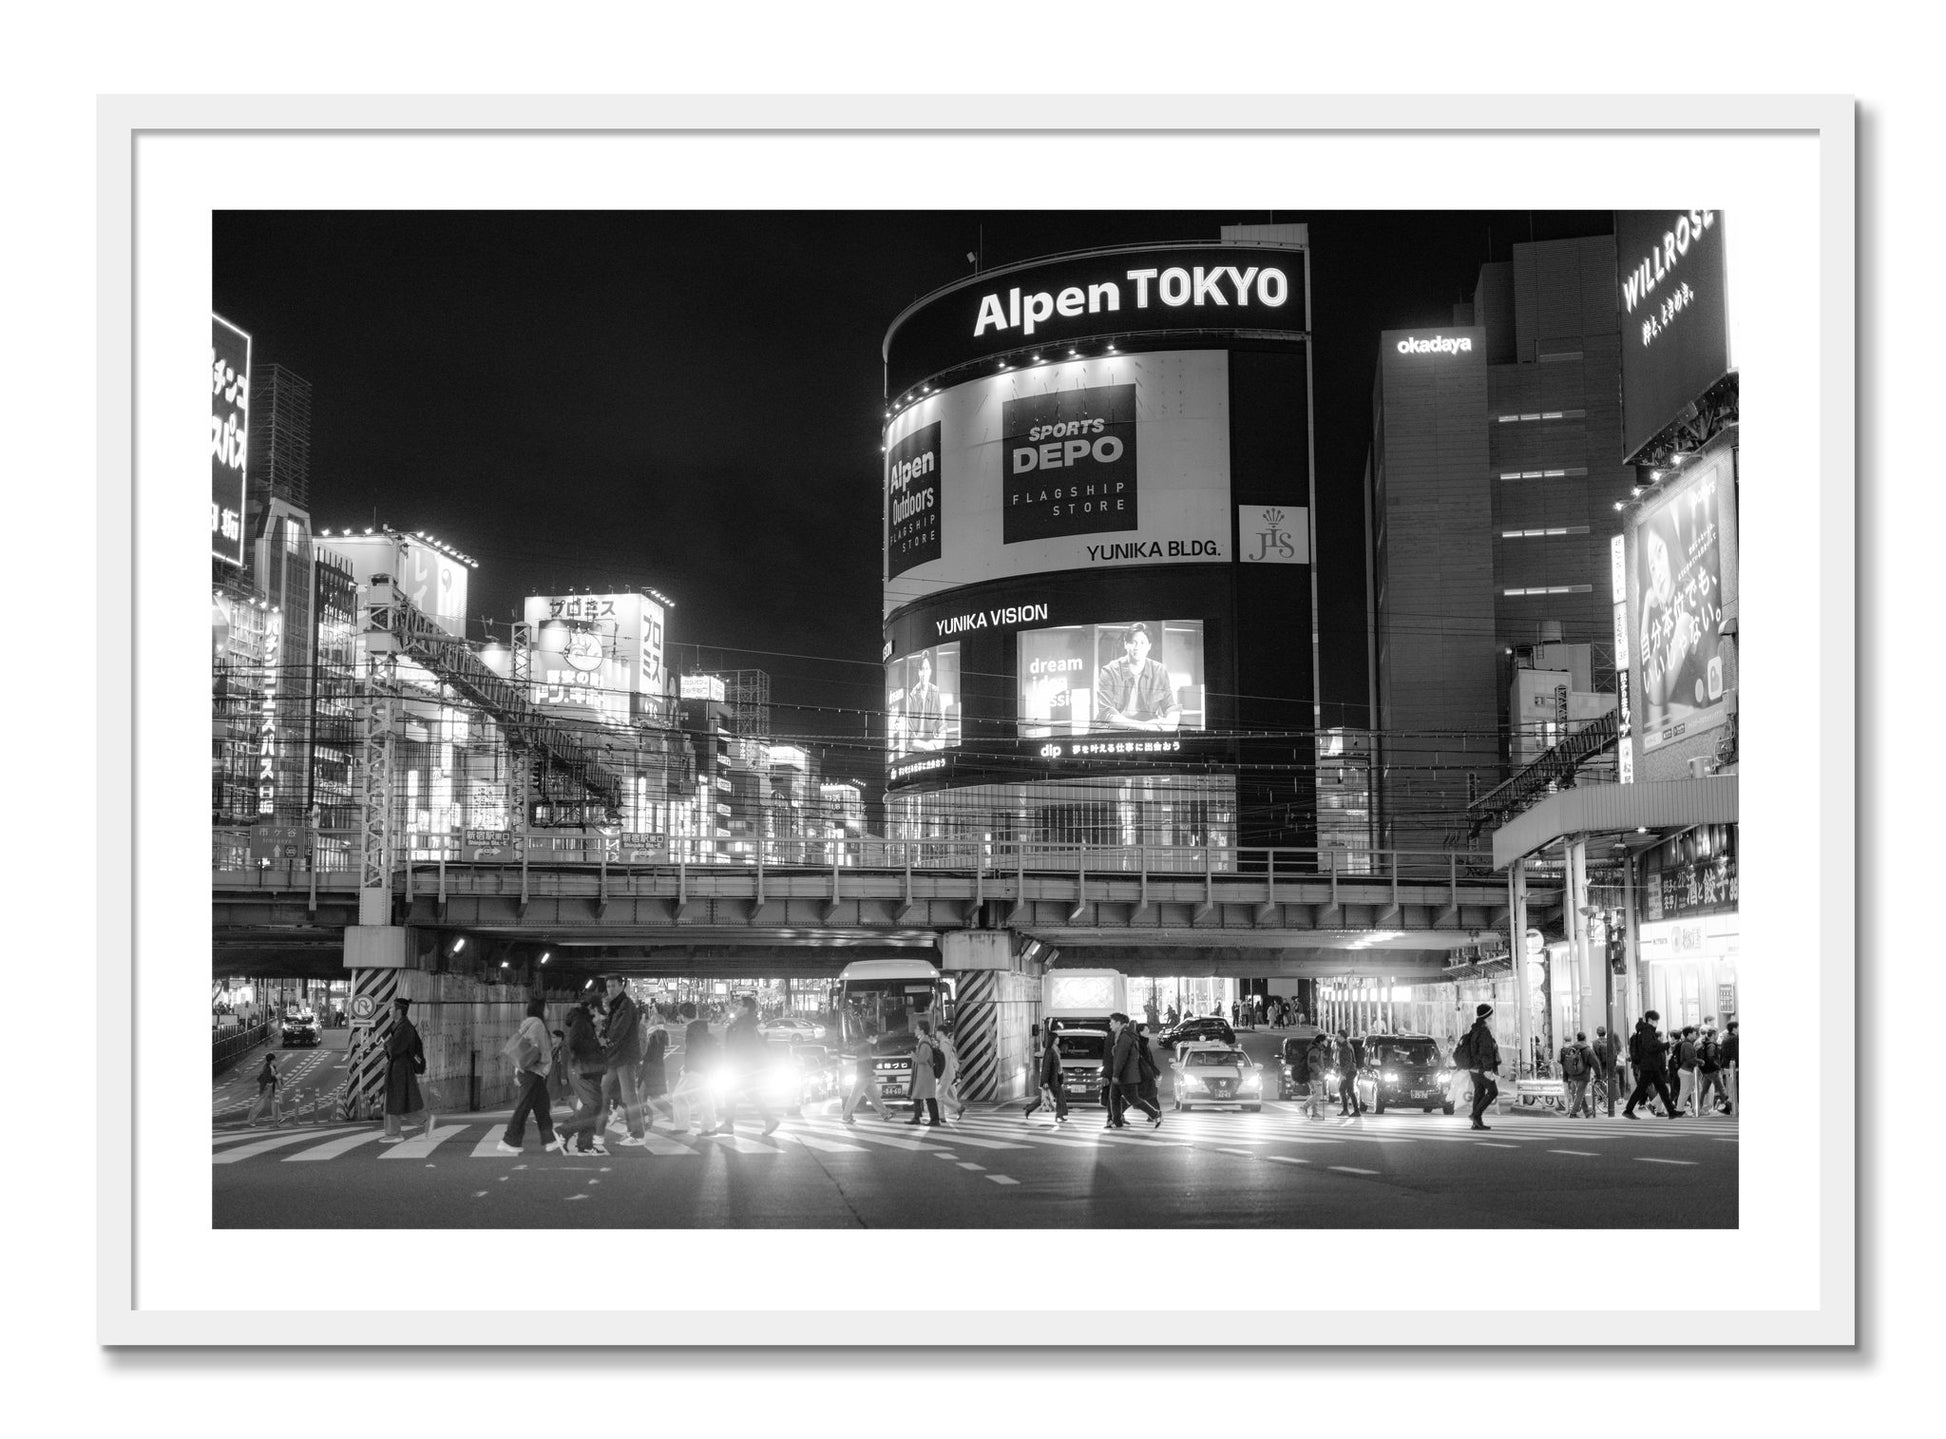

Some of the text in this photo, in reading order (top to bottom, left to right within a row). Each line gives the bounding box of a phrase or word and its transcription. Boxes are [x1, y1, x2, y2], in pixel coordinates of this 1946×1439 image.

[973, 266, 1288, 336] Alpen TOKYO
[1397, 335, 1472, 355] okadaya
[212, 348, 246, 410] チンコ
[1028, 418, 1105, 442] SPORTS
[1013, 435, 1124, 475] DEPO
[890, 451, 935, 495] Alpen
[1012, 482, 1125, 506] FLAGSHIP
[893, 487, 934, 526] Outdoors
[1052, 499, 1125, 516] STORE
[890, 514, 935, 547] FLAGSHIP
[902, 530, 935, 553] STORE
[1087, 540, 1222, 561] YUNIKA BLDG.
[324, 603, 352, 624] SHISHA
[550, 599, 616, 617] プロミス
[936, 603, 1048, 636] YUNIKA VISION
[643, 614, 661, 684] プロミス
[1030, 658, 1083, 674] dream
[258, 619, 280, 814] パチンコエスパス日拓
[1040, 744, 1061, 758] dip
